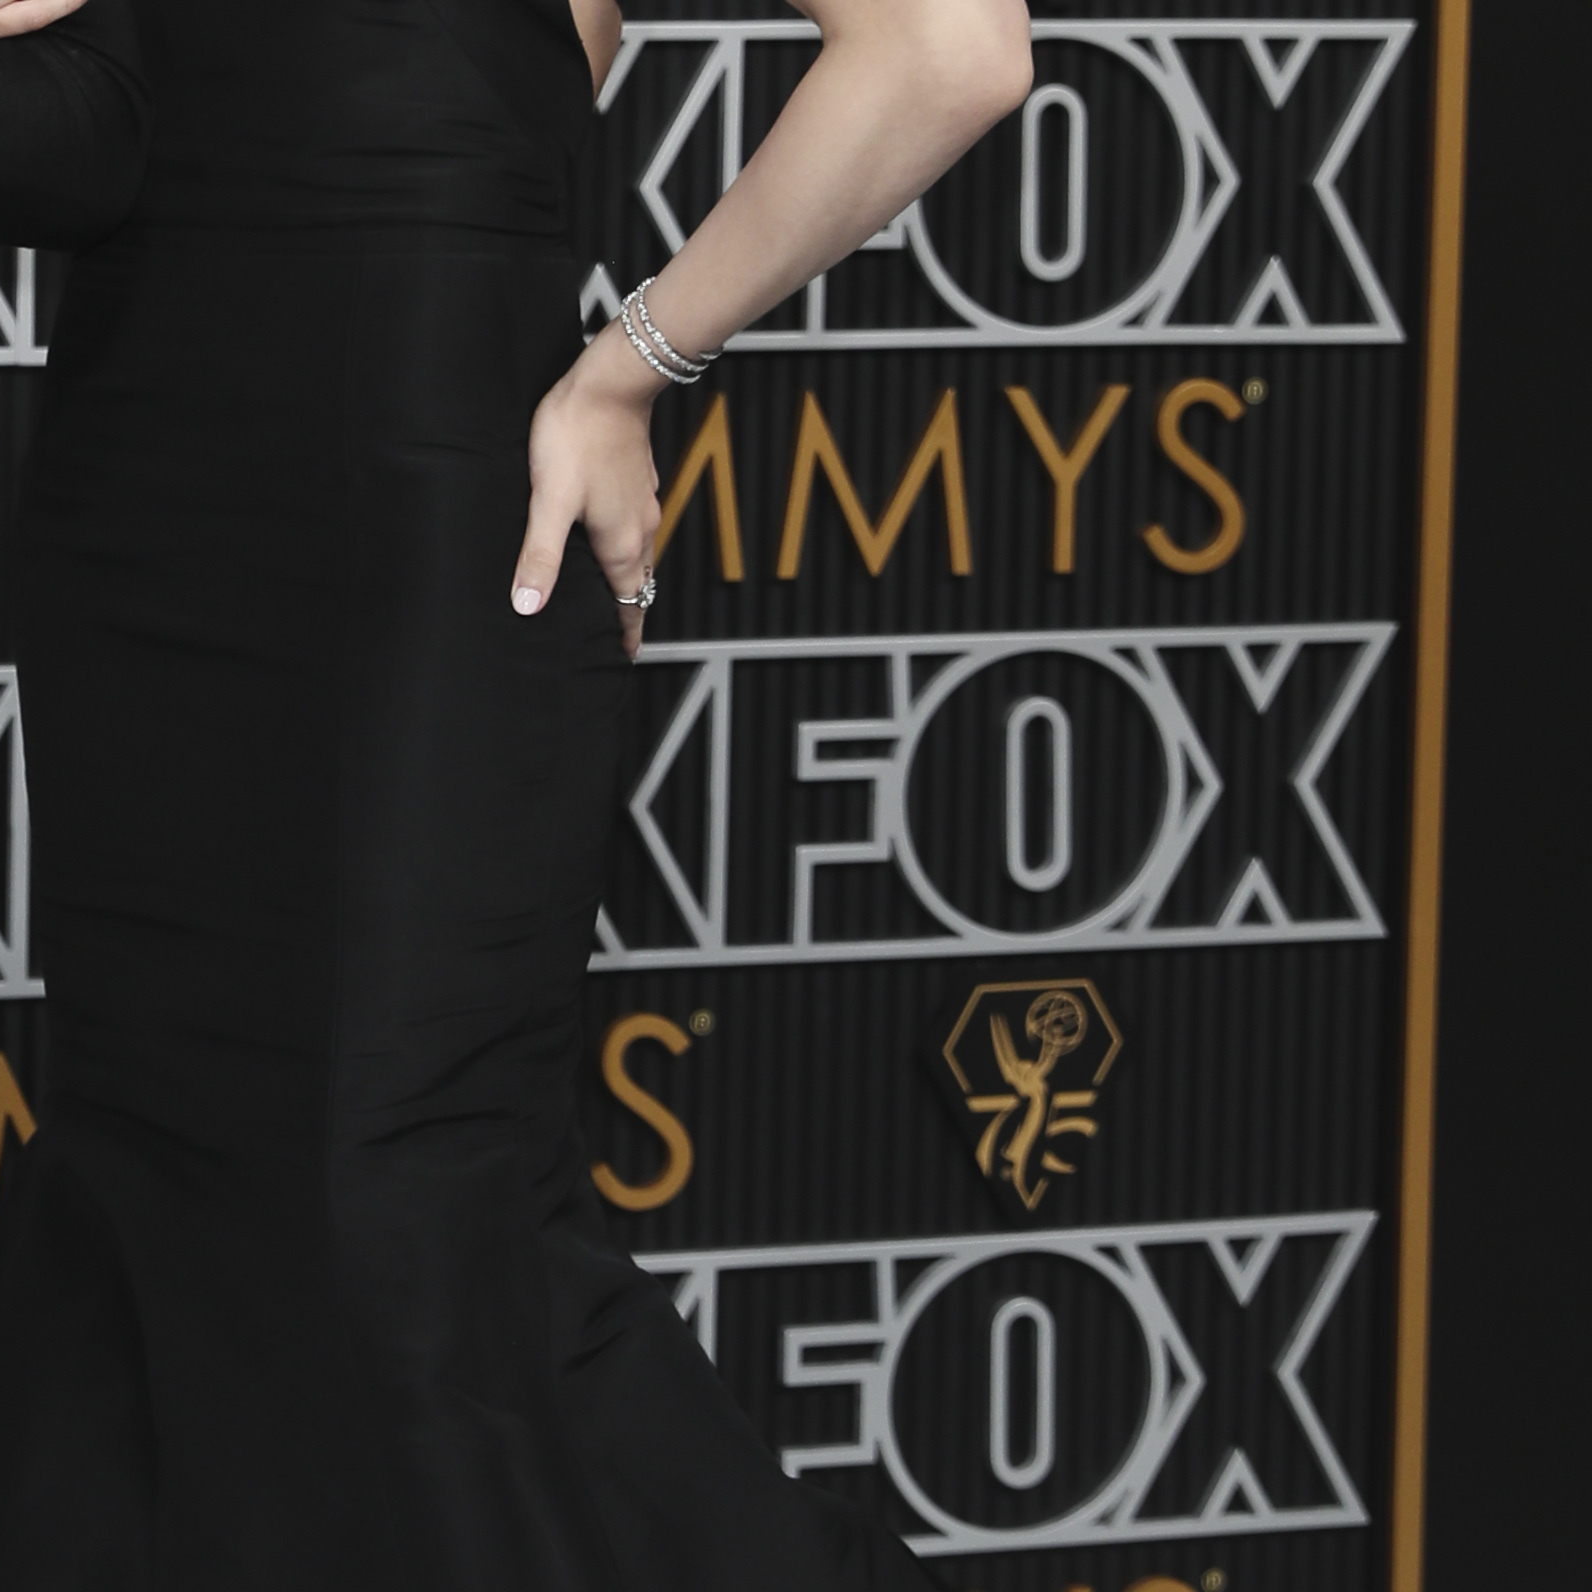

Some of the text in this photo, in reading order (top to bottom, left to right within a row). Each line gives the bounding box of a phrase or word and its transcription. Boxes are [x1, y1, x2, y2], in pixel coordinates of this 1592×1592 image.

[720, 21, 1416, 350] OX
[709, 622, 1397, 960] FOX
[698, 1211, 1378, 1557] FOX
